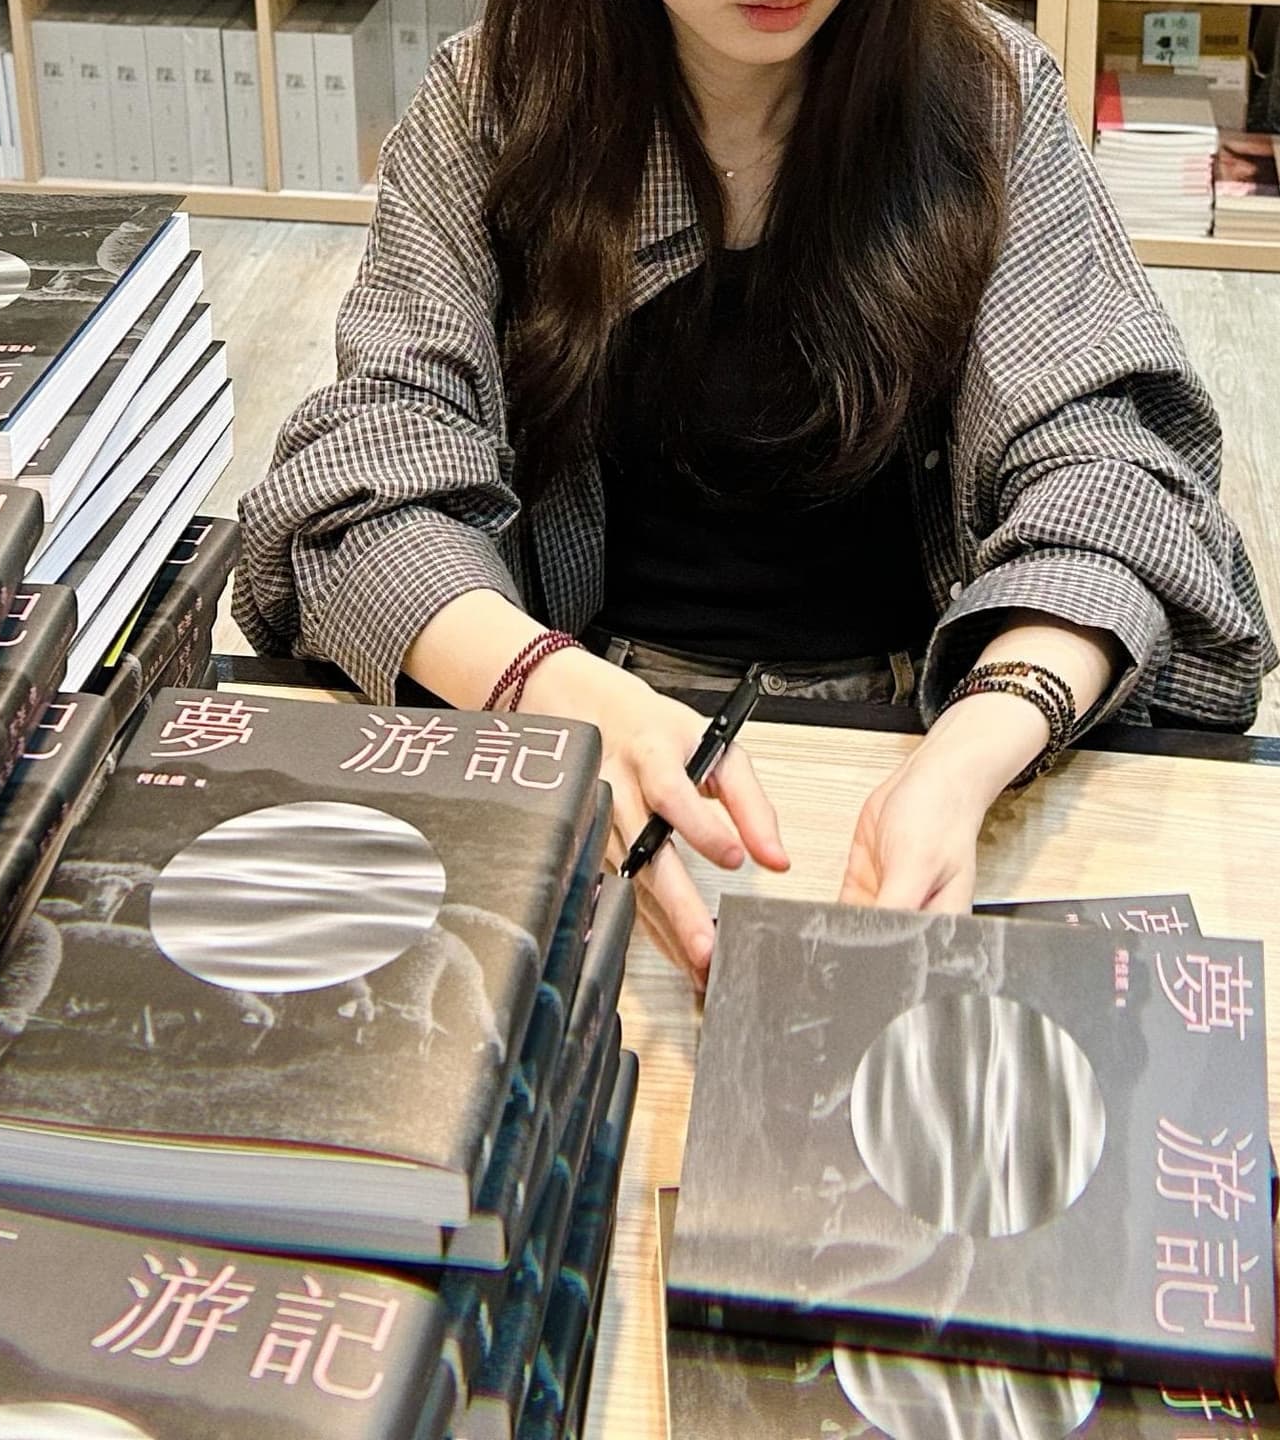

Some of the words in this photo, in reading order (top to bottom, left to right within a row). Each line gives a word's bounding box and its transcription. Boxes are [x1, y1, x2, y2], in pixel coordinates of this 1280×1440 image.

[150, 696, 270, 758] 夢
[339, 712, 570, 791] 游記
[1156, 952, 1255, 1040] 夢
[1155, 1115, 1257, 1334] 游記
[91, 1252, 401, 1402] 游記
